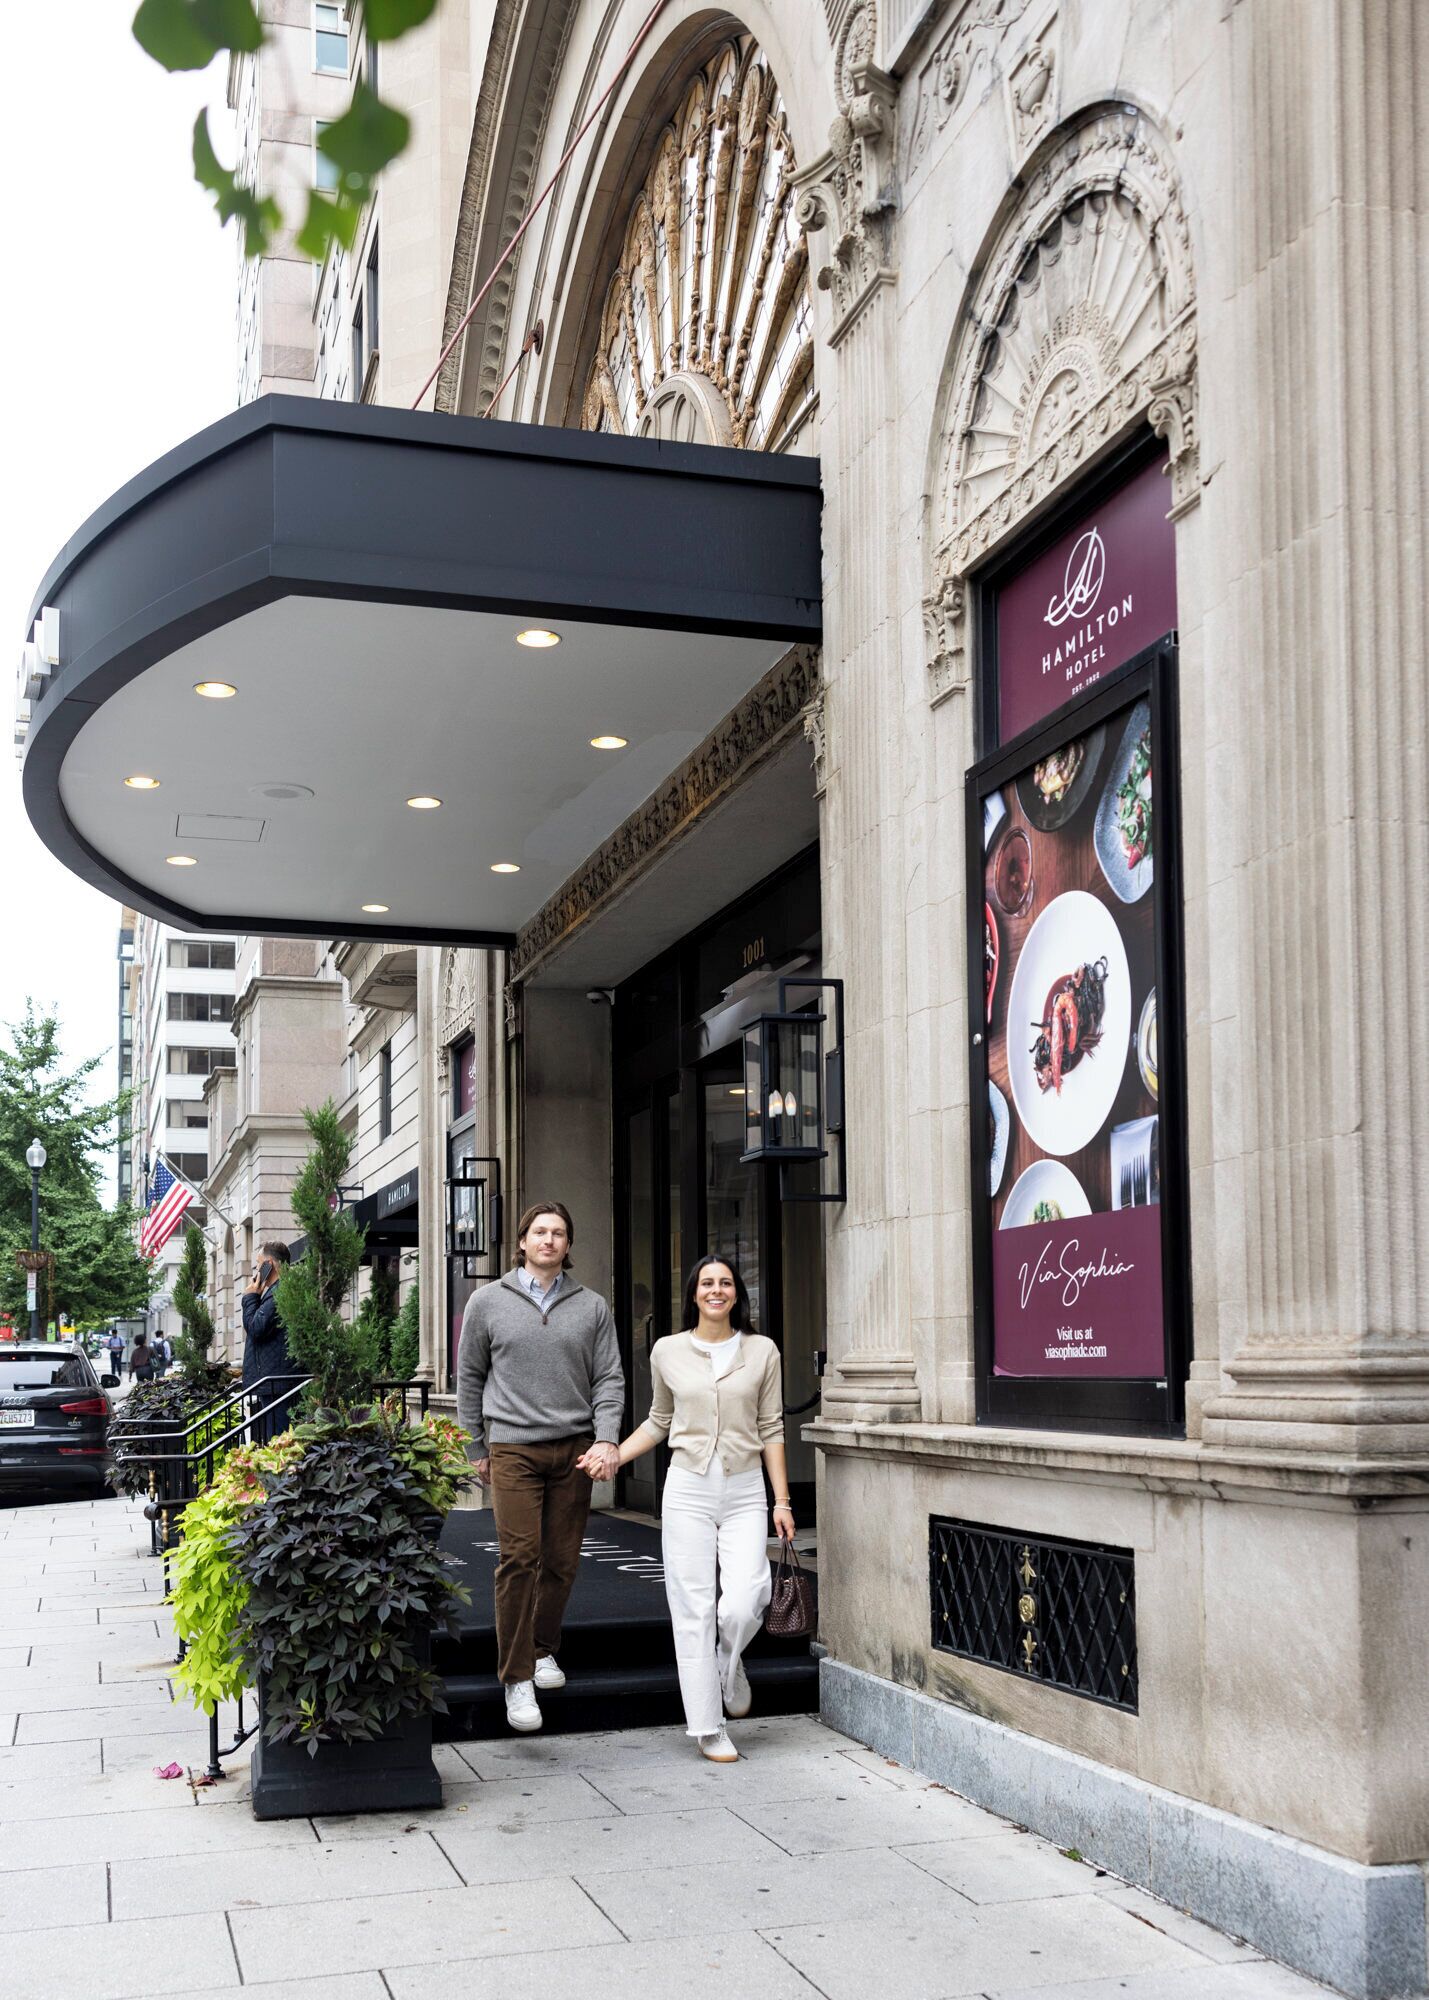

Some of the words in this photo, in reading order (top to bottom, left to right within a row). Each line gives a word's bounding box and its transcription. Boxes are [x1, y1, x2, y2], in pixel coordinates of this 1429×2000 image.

[1042, 594, 1133, 674] HAMILTON
[1065, 645, 1106, 681] HOTEL
[743, 936, 765, 968] 1001
[1018, 1240, 1062, 1309] Via
[1059, 1239, 1135, 1307] Sophia
[1056, 1326, 1073, 1341] Visit
[1074, 1329, 1084, 1340] us
[1084, 1326, 1093, 1340] at
[1044, 1342, 1107, 1360] viasophiadc.com
